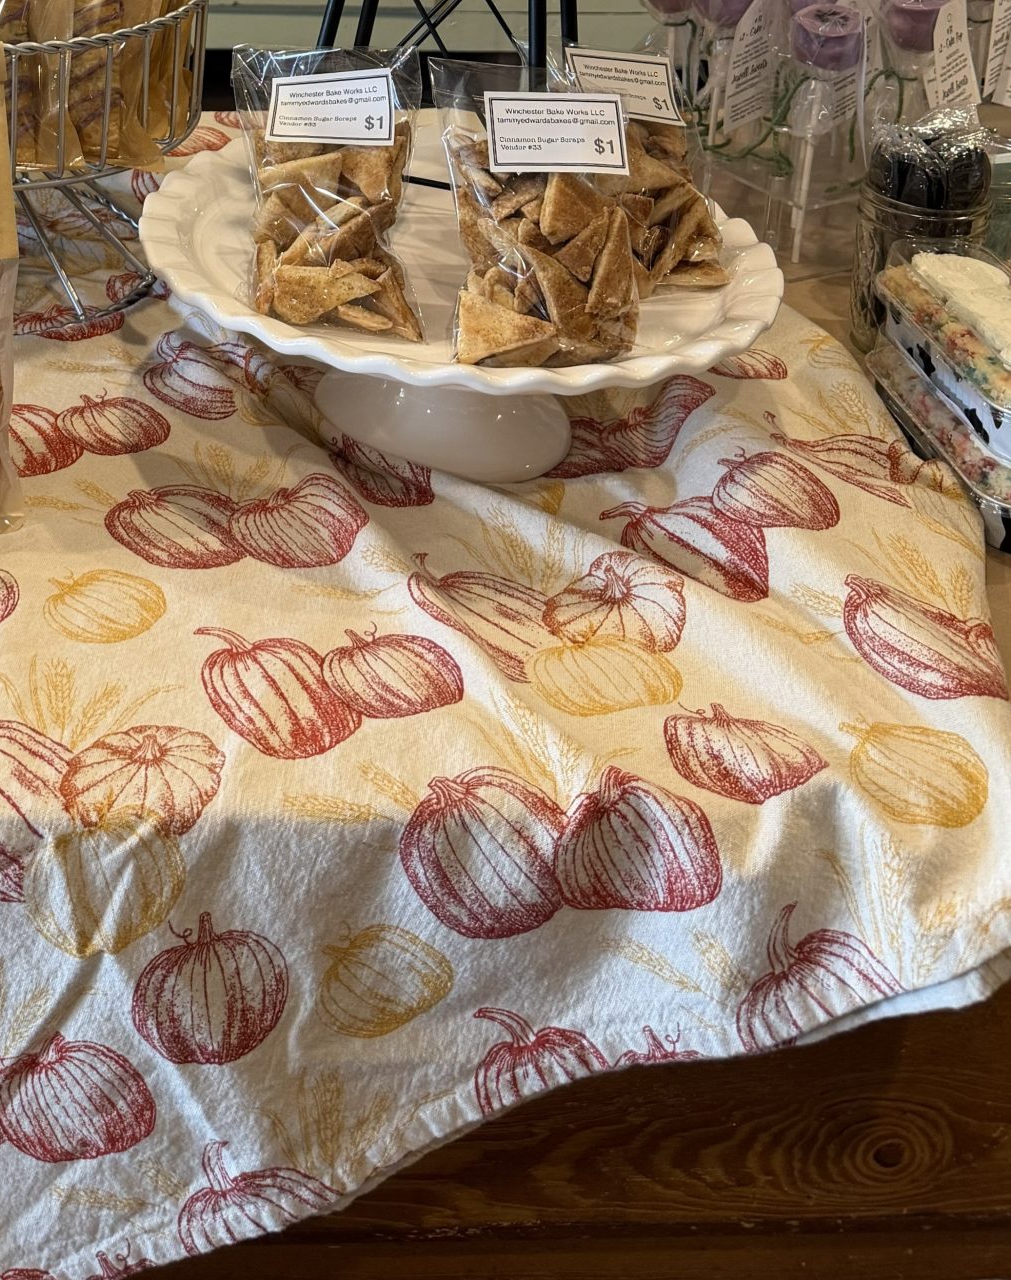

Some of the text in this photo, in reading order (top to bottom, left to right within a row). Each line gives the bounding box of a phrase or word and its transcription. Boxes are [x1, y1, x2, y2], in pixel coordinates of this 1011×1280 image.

[289, 85, 378, 99] Winchester Bake Works LLC
[652, 96, 670, 111] $1
[566, 108, 589, 116] Works
[364, 114, 385, 131] $1
[593, 137, 615, 155] $1
